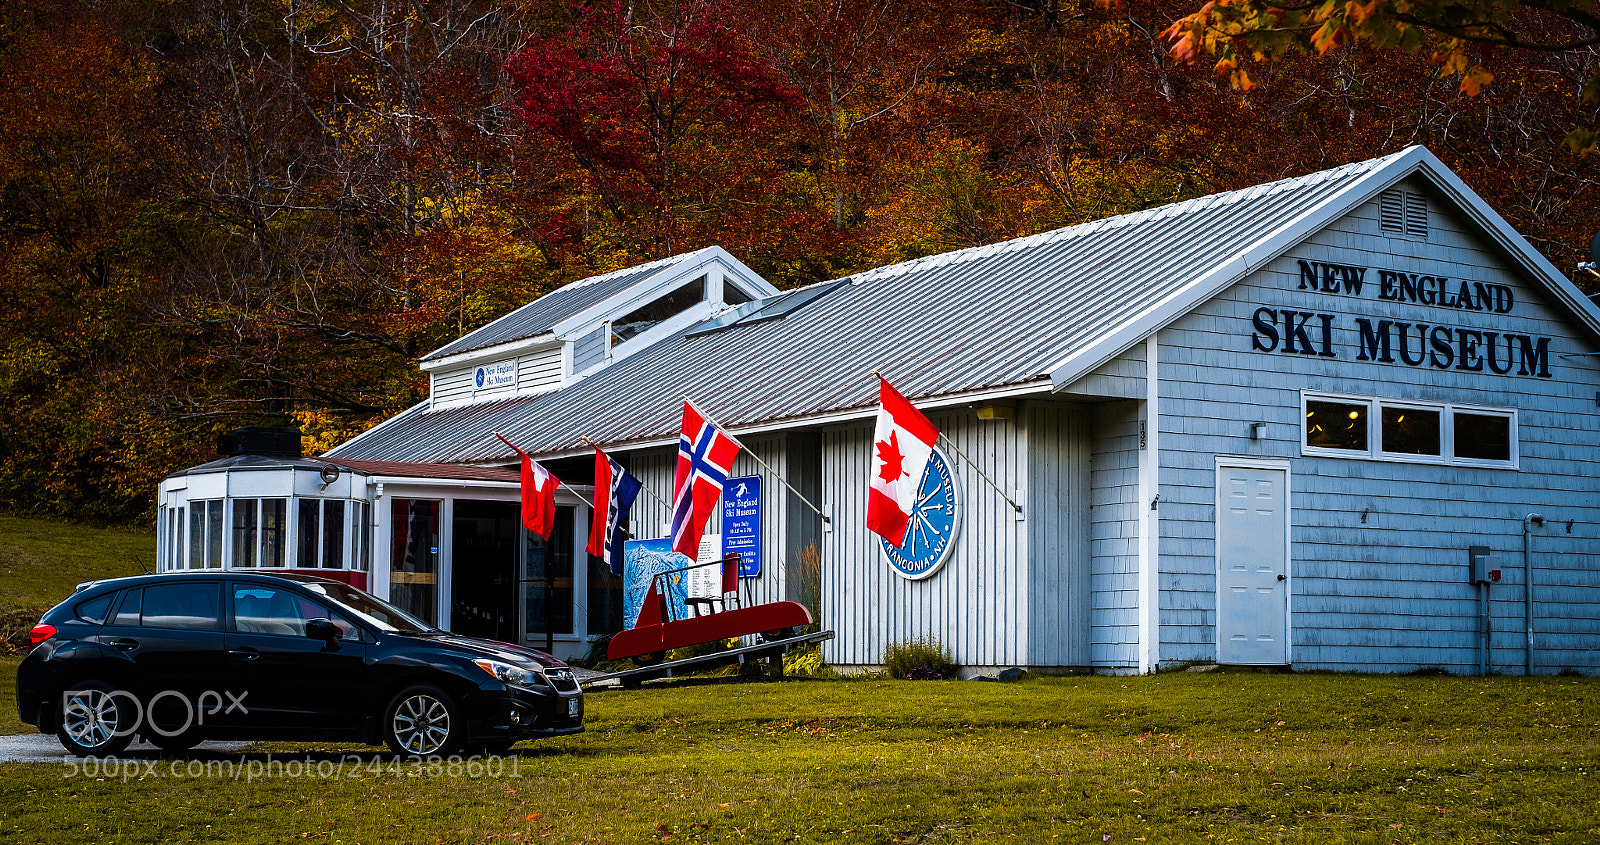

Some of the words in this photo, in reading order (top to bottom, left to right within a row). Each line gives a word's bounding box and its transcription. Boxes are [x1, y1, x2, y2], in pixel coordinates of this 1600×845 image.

[1297, 259, 1367, 296] NEW
[1377, 269, 1514, 314] ENGLAND
[1252, 306, 1336, 357] SKI
[1356, 317, 1552, 378] MUSEUM
[496, 361, 514, 375] England
[494, 375, 513, 384] Museum
[935, 460, 954, 516] MUSEUM
[724, 500, 736, 508] New
[737, 497, 758, 508] England
[725, 509, 735, 517] Ski
[735, 508, 757, 517] Museum
[933, 536, 948, 557] NH
